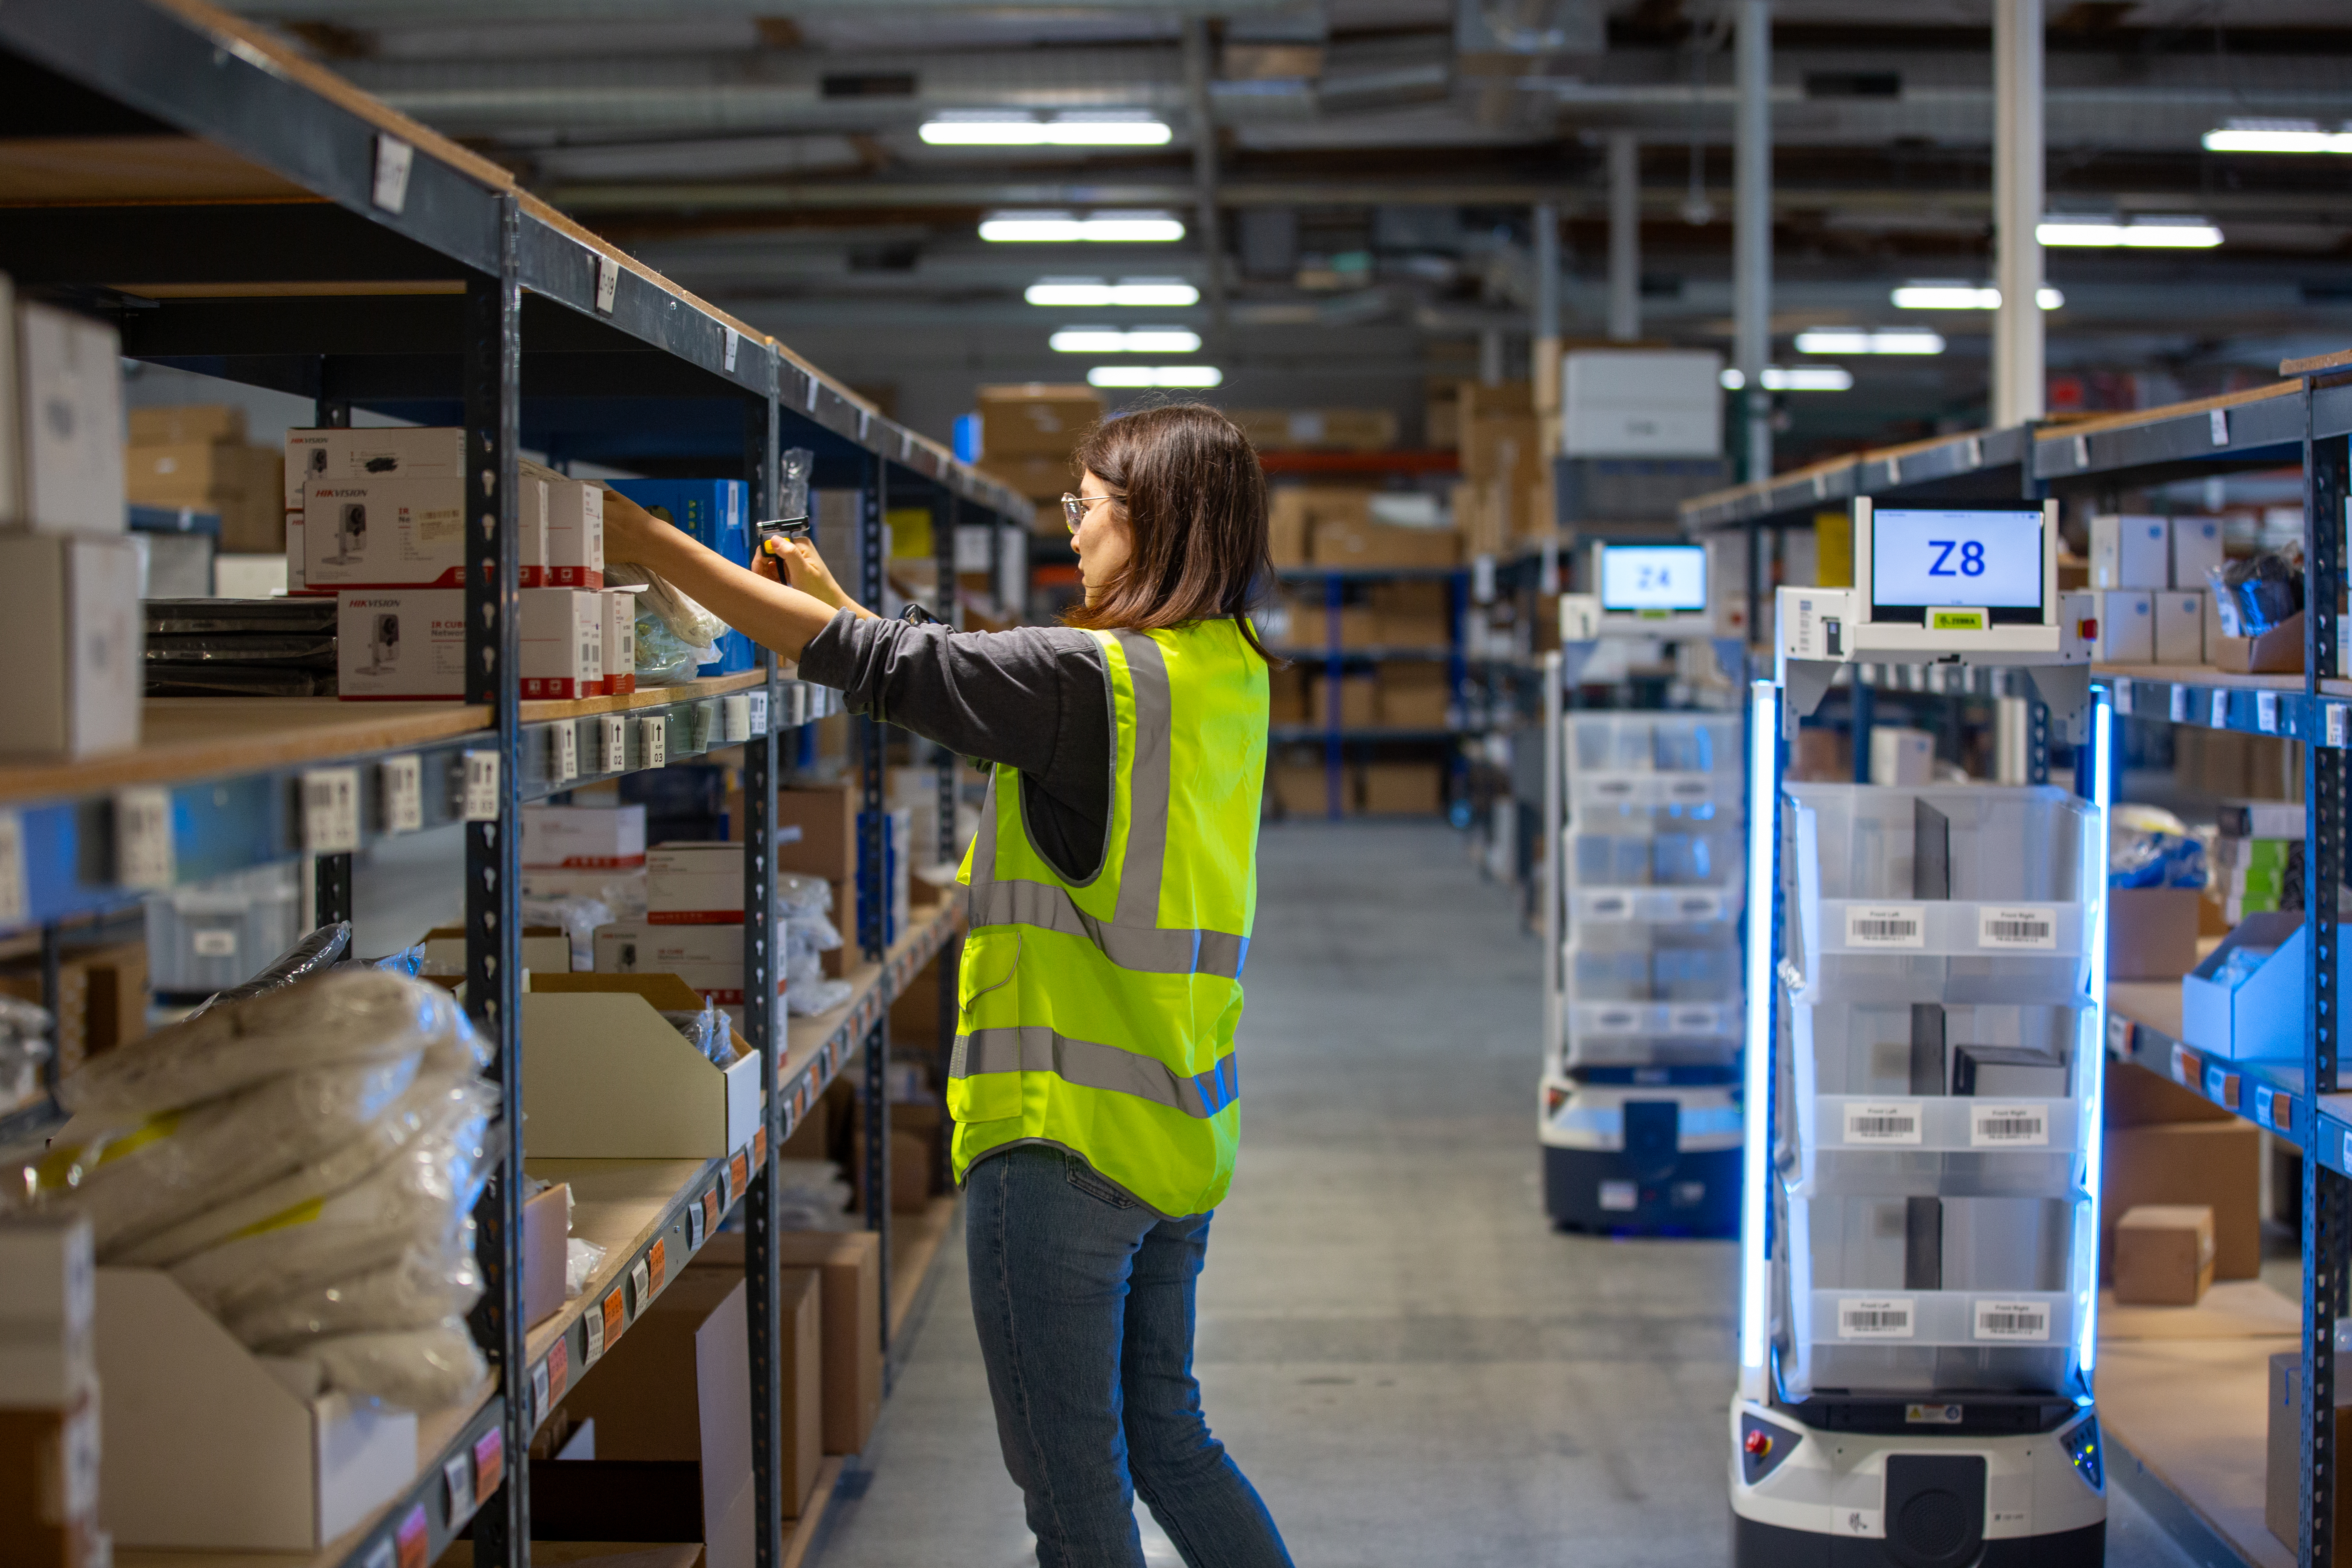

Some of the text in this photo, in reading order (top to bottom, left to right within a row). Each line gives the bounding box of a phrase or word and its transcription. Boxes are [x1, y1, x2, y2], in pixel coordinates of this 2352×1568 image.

[316, 489, 368, 497] HIKVISION
[1928, 540, 1985, 577] Z8
[1637, 564, 1671, 589] Z4
[350, 599, 401, 608] HIKVISION
[614, 755, 622, 765] 02
[654, 753, 663, 762] 03
